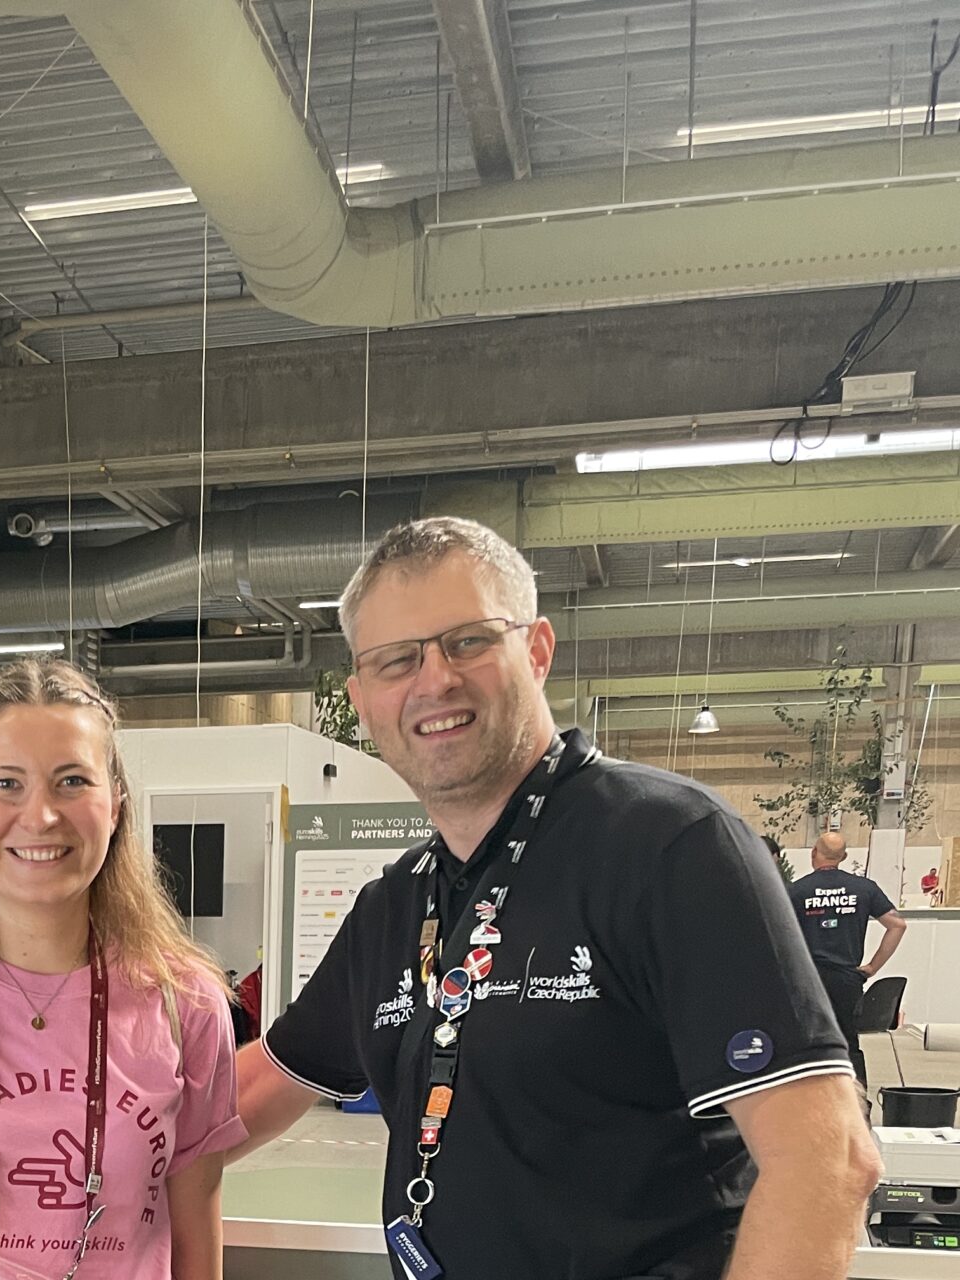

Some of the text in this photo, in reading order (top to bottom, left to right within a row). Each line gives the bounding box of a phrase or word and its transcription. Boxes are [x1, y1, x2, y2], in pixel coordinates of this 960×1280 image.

[351, 819, 384, 828] THANK
[386, 818, 408, 827] YOU
[410, 818, 423, 827] TO
[351, 829, 433, 839] PARTNERS AND
[815, 887, 846, 896] Expert
[805, 895, 857, 909] FRANCE
[530, 973, 591, 989] worldskills
[527, 985, 601, 1003] CzechRepublic
[116, 1090, 167, 1225] EUROPE
[887, 1190, 923, 1198] FESTOOL
[41, 1238, 79, 1252] your
[85, 1236, 125, 1252] skills
